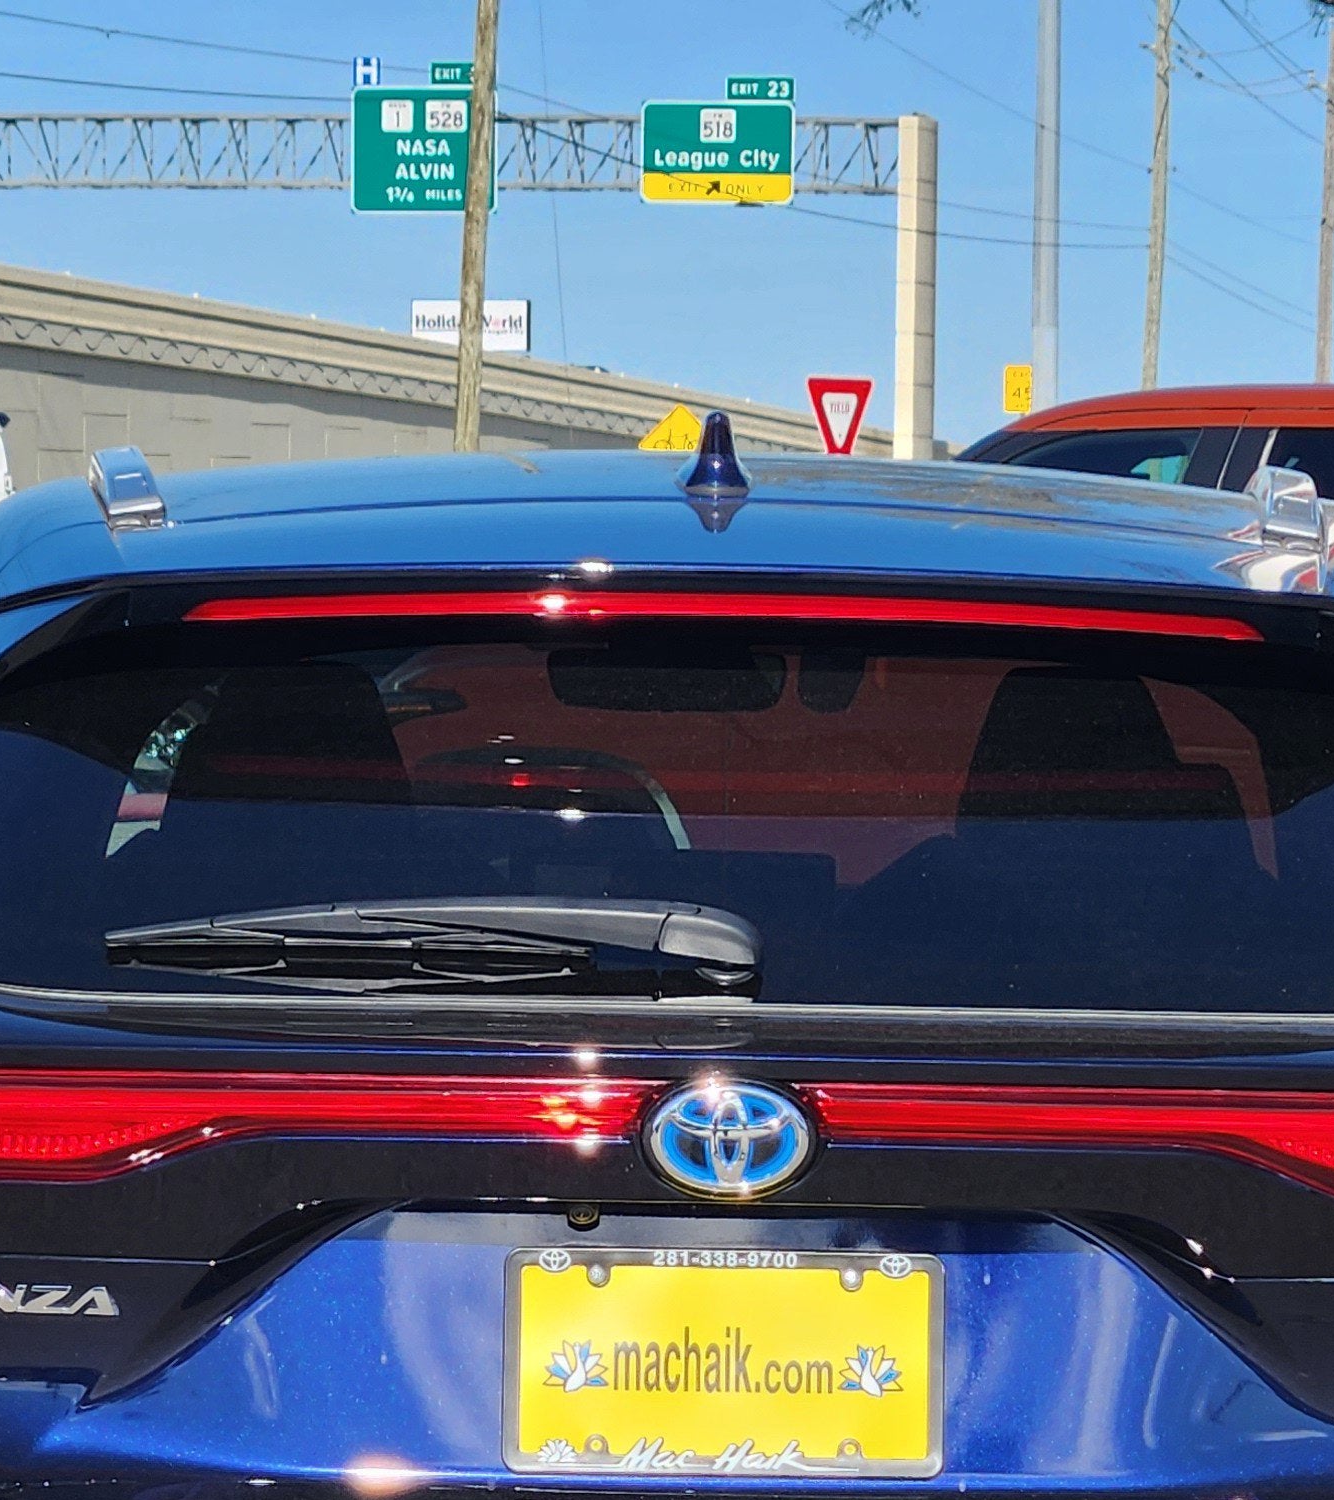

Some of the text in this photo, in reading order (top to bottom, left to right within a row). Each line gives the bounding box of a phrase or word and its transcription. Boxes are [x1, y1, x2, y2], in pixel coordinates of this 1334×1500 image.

[433, 67, 462, 81] EXIT
[731, 80, 790, 98] EXIT 23
[429, 110, 464, 129] 528
[703, 120, 733, 138] 518
[395, 138, 451, 157] NASA
[654, 148, 780, 172] League City
[394, 162, 455, 181] ALVIN
[425, 188, 463, 202] MILES
[725, 183, 765, 195] ONLY
[415, 314, 462, 329] Holid
[653, 1250, 799, 1269] 281-338-9700
[612, 1326, 834, 1395] machaik.com
[619, 1436, 697, 1471] Mac
